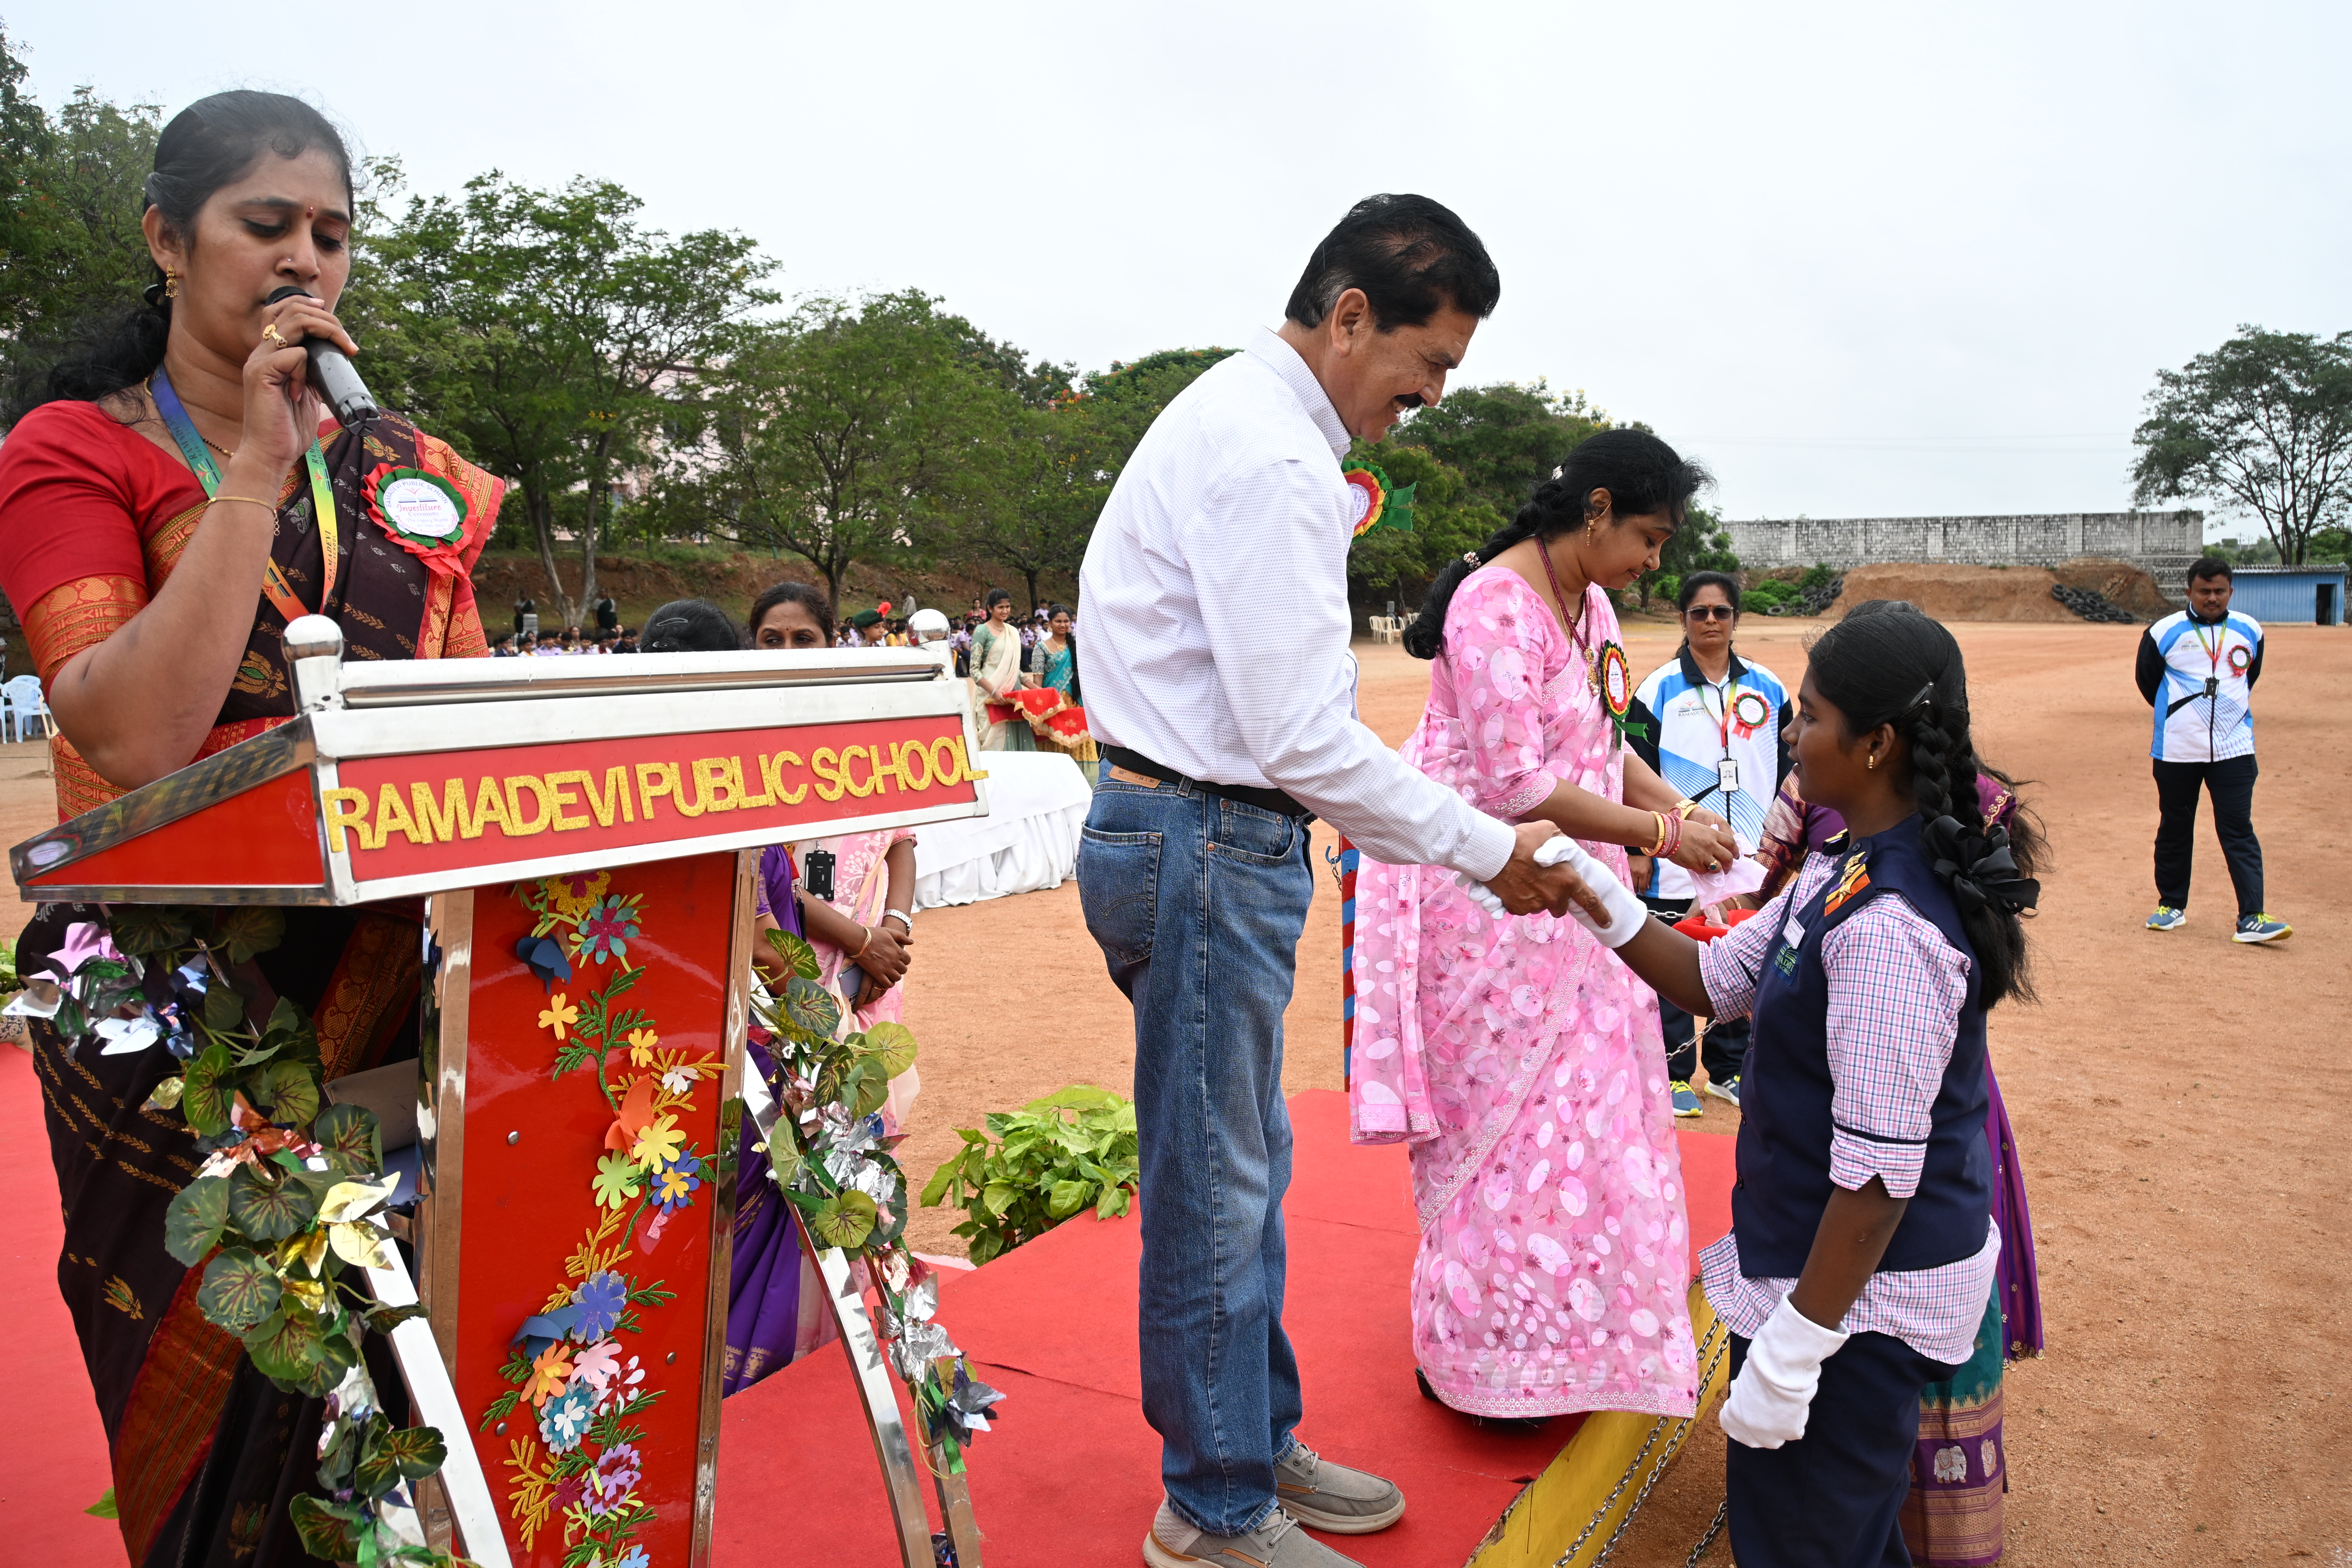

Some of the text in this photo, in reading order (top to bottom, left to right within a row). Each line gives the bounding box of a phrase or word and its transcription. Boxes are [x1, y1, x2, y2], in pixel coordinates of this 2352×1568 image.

[309, 444, 319, 464] RAM
[386, 483, 402, 508] RAMADEVI
[426, 485, 449, 504] SCHOOL
[397, 503, 441, 512] Investiture
[322, 735, 989, 852] RAMADEVI PUBLIC SCHOOL
